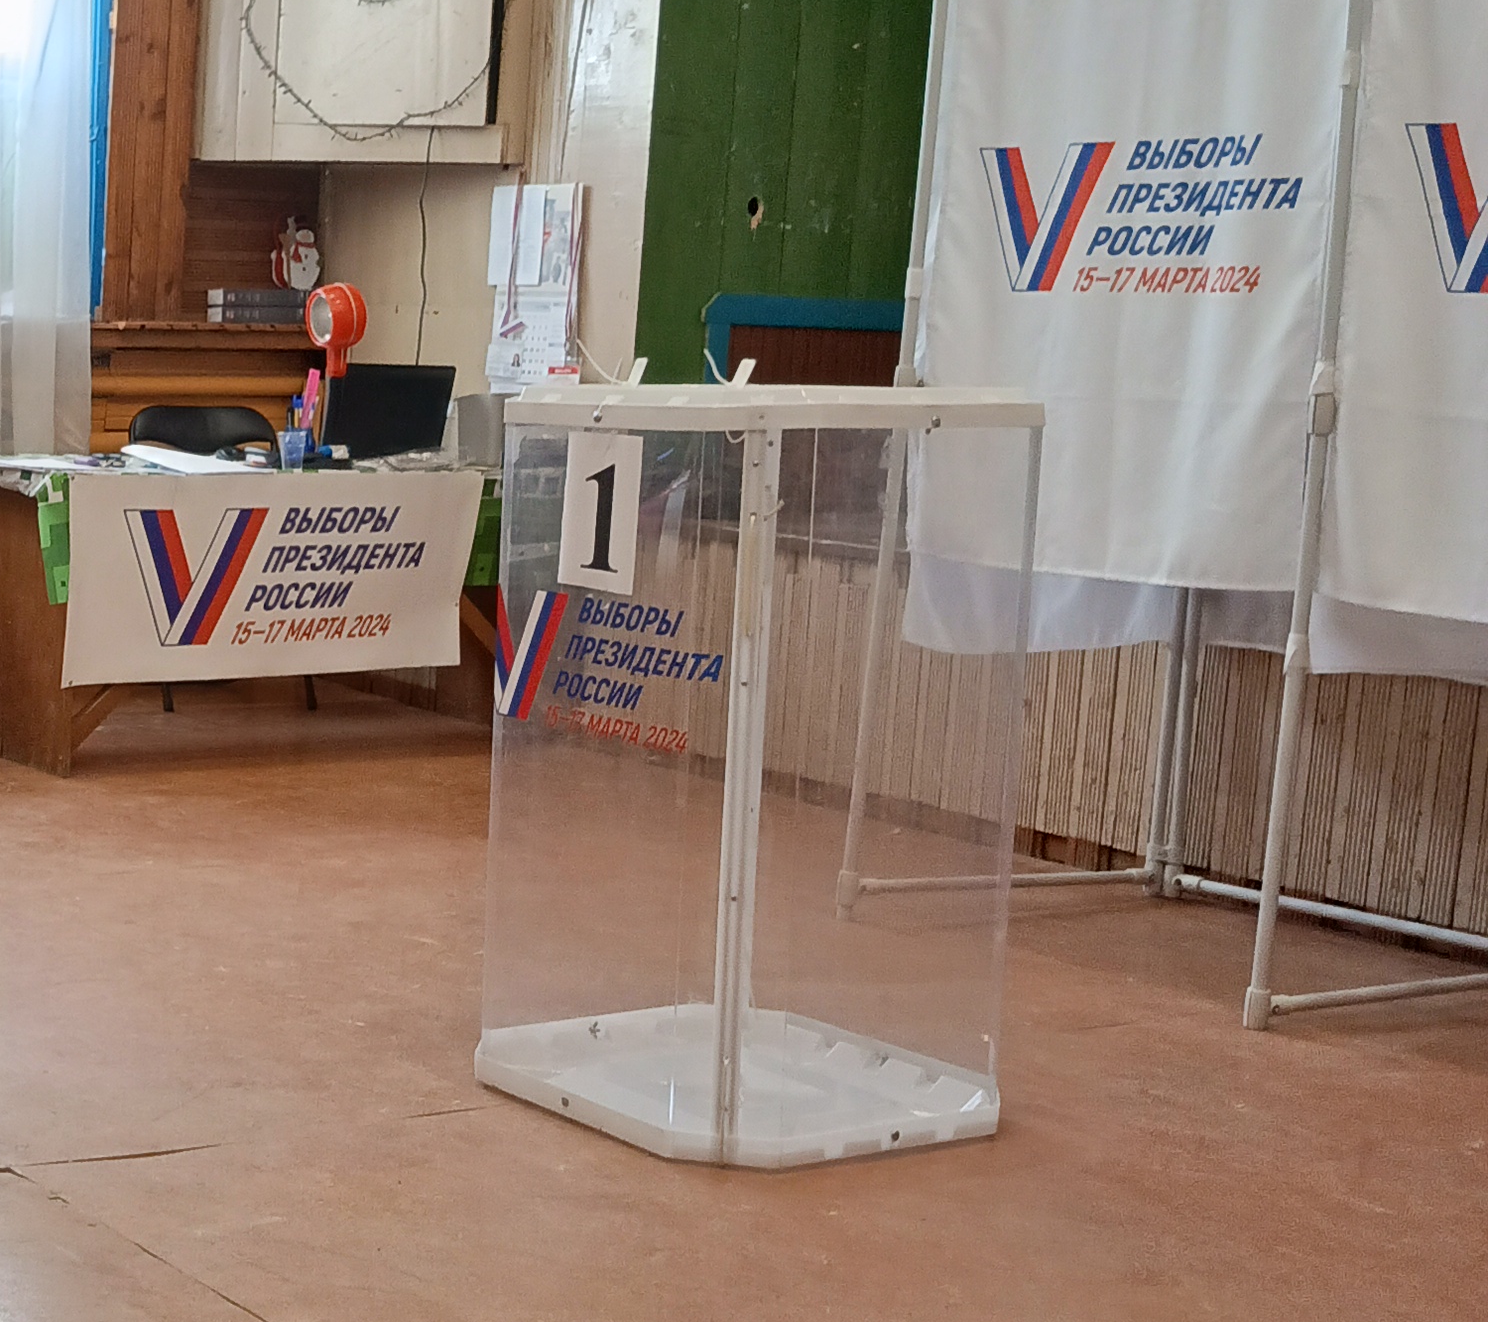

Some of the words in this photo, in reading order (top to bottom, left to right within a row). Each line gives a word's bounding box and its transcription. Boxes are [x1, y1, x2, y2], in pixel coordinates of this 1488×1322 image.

[1126, 133, 1263, 170] ВЫБОРЫ
[1106, 177, 1303, 217] ПРЕЗИДЕНТА
[1086, 225, 1215, 256] РОССИИ
[1134, 266, 1210, 294] МАРТА
[1210, 265, 1261, 294] 2024
[279, 506, 402, 535] ВЫБОРЫ
[580, 464, 618, 573] 1
[262, 542, 426, 575] ПРЕЗИДЕНТА
[244, 581, 354, 612] РОССИИ
[283, 616, 348, 643] МАРТА
[347, 613, 392, 638] 2024
[578, 597, 685, 637] ВЫБОРЫ
[565, 634, 724, 682] ПРЕЗИДЕНТА
[552, 671, 644, 710] РОССИИ
[585, 713, 642, 745] МАРТА
[642, 726, 689, 755] 2024
